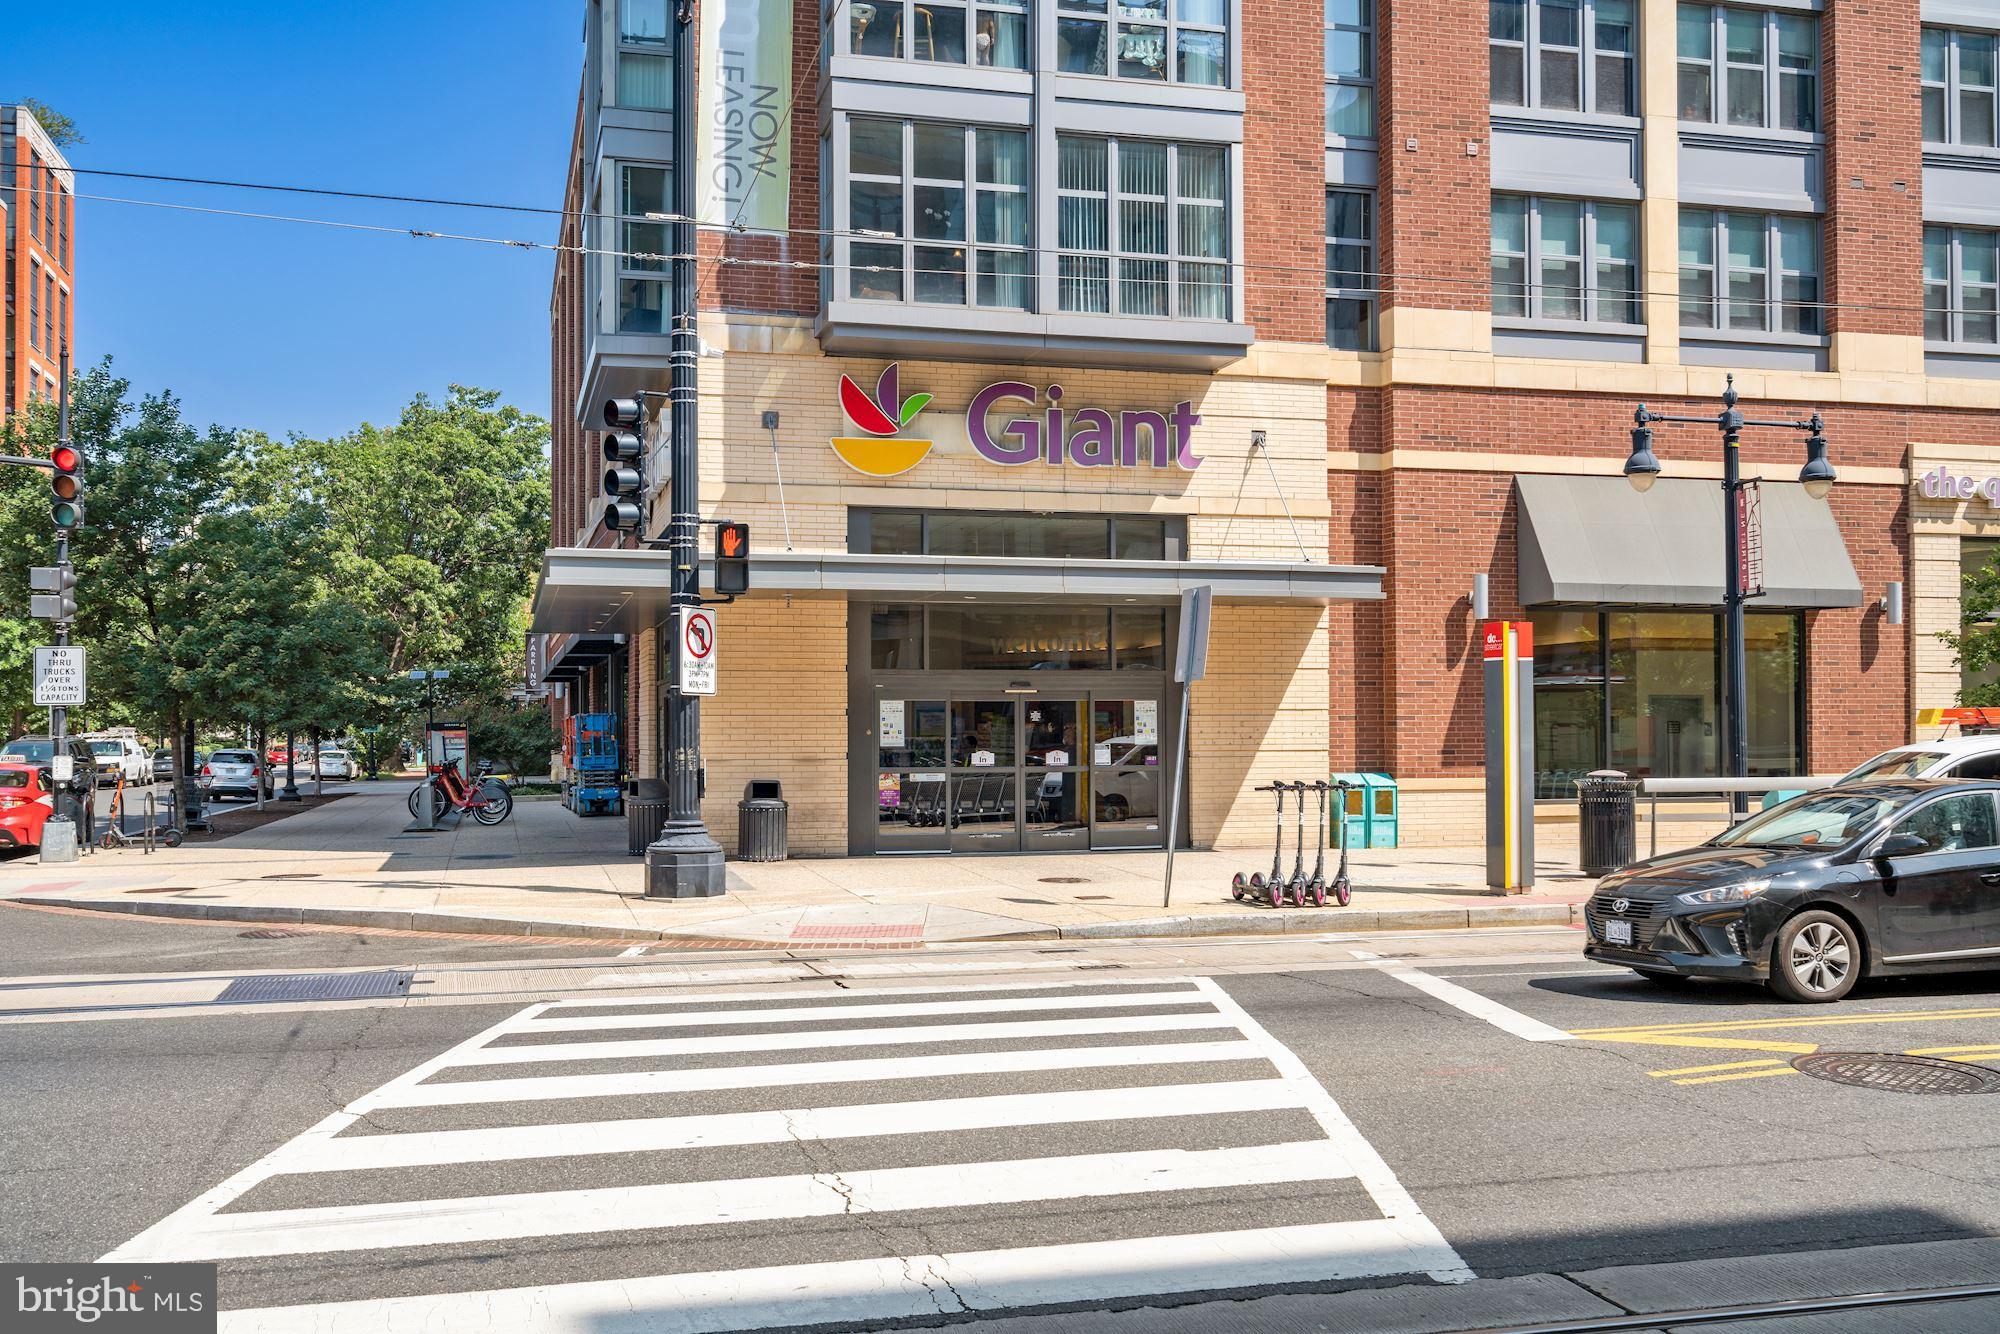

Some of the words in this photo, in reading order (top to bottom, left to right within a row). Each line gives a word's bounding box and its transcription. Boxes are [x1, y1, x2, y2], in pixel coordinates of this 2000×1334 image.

[712, 49, 745, 203] LEASING!
[748, 84, 779, 179] NOW
[967, 381, 1208, 471] Giant
[1920, 465, 1976, 499] the
[48, 676, 71, 684] OVER
[529, 637, 537, 686] PARKING
[40, 693, 78, 701] CAPACITY
